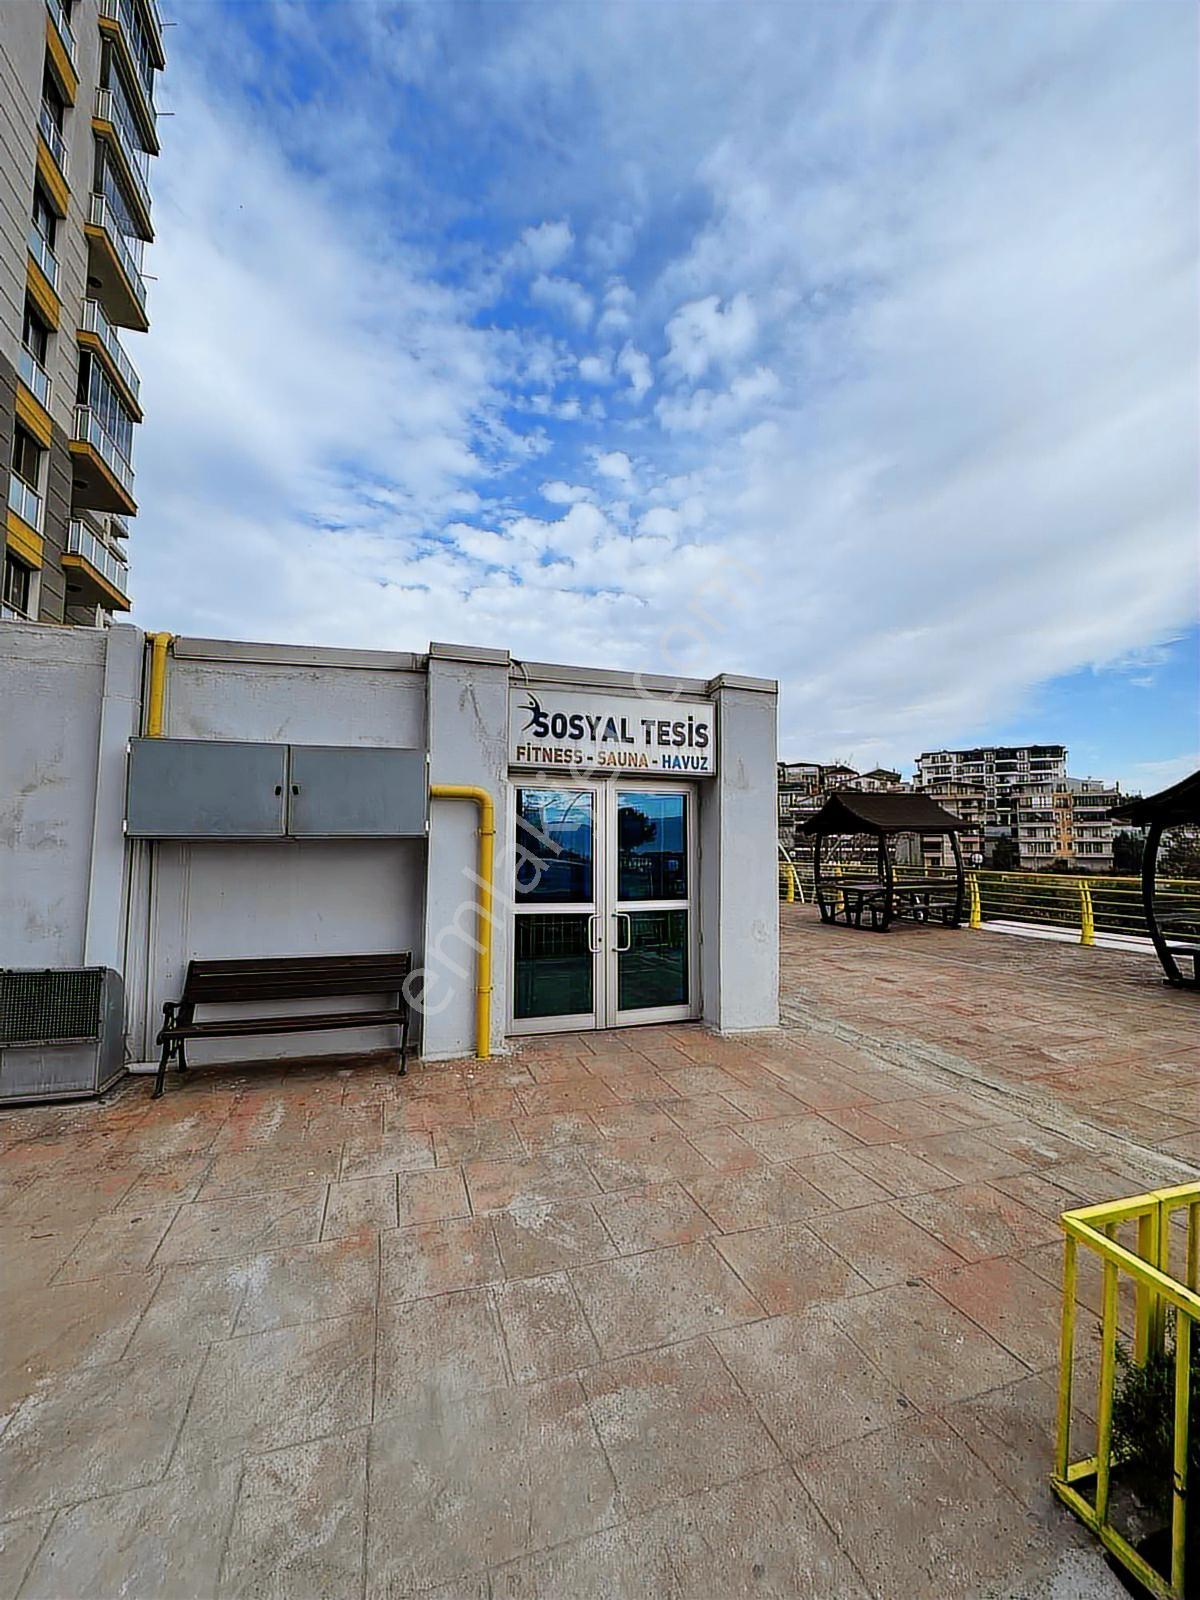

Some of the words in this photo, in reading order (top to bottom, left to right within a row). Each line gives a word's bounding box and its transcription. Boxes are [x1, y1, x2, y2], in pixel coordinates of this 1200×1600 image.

[532, 711, 635, 744] SOSYAL
[641, 716, 709, 748] TESİS
[516, 742, 583, 764] FİTNESS
[597, 750, 649, 768] SAUNA
[662, 754, 708, 771] HAVUZ
